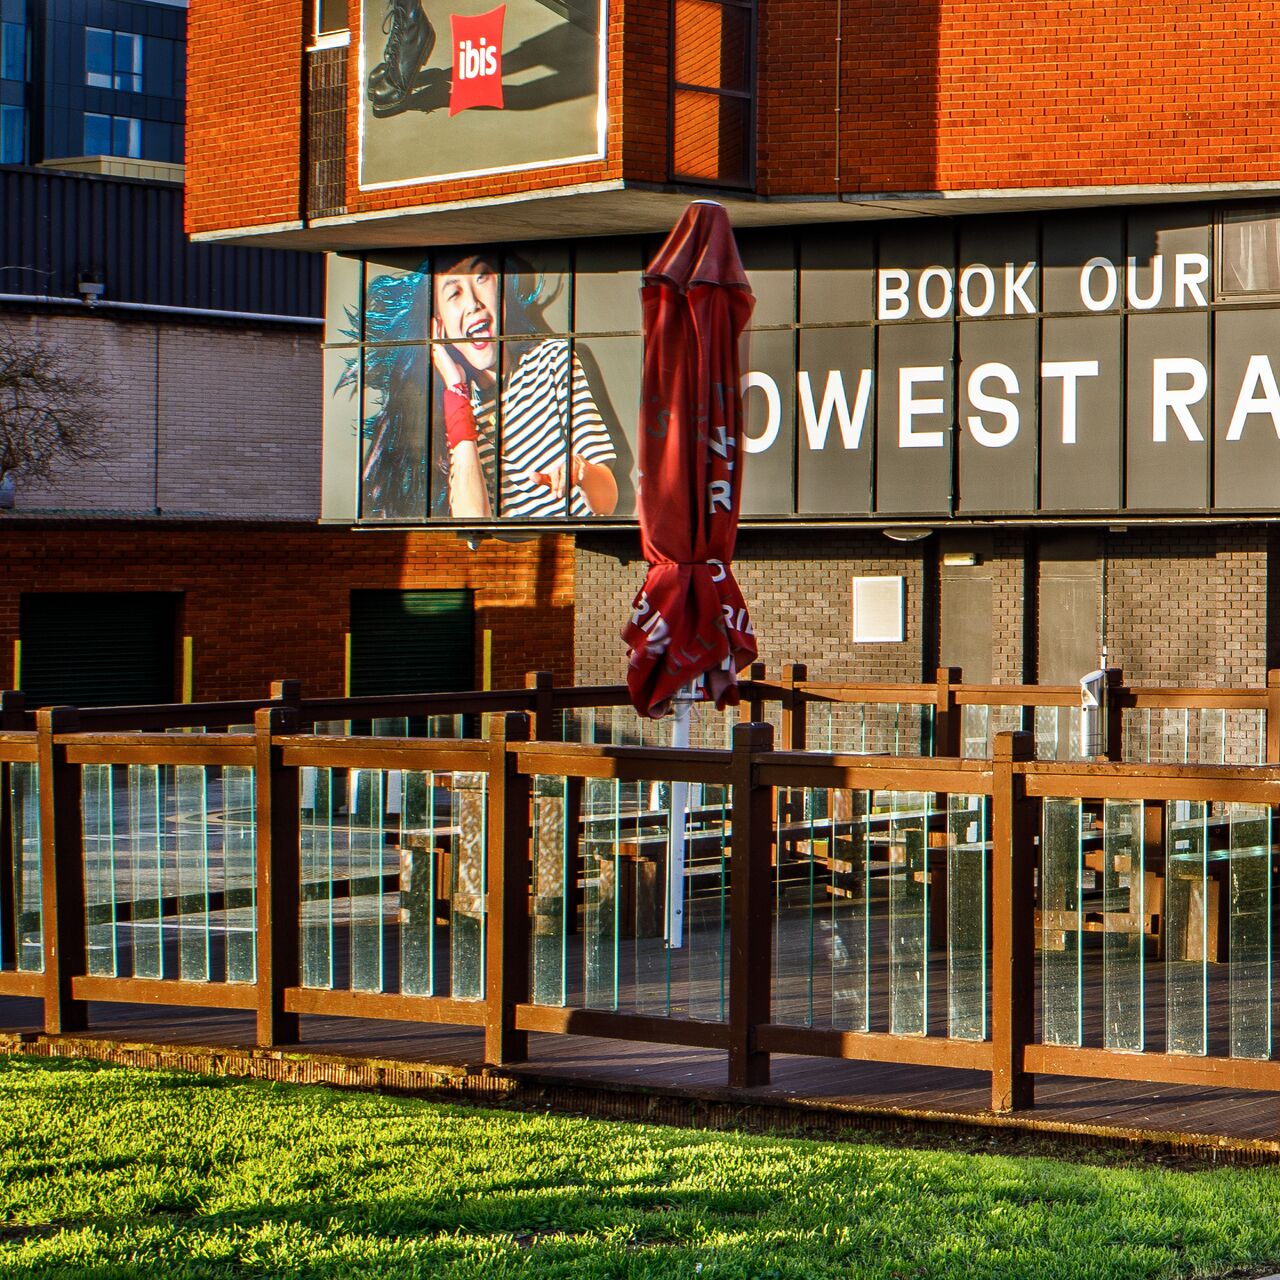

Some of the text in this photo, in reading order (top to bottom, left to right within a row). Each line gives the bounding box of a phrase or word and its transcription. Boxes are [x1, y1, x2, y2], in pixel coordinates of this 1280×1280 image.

[459, 37, 498, 80] ibis
[877, 253, 1209, 321] BOOK OUR
[739, 360, 1100, 455] OWEST
